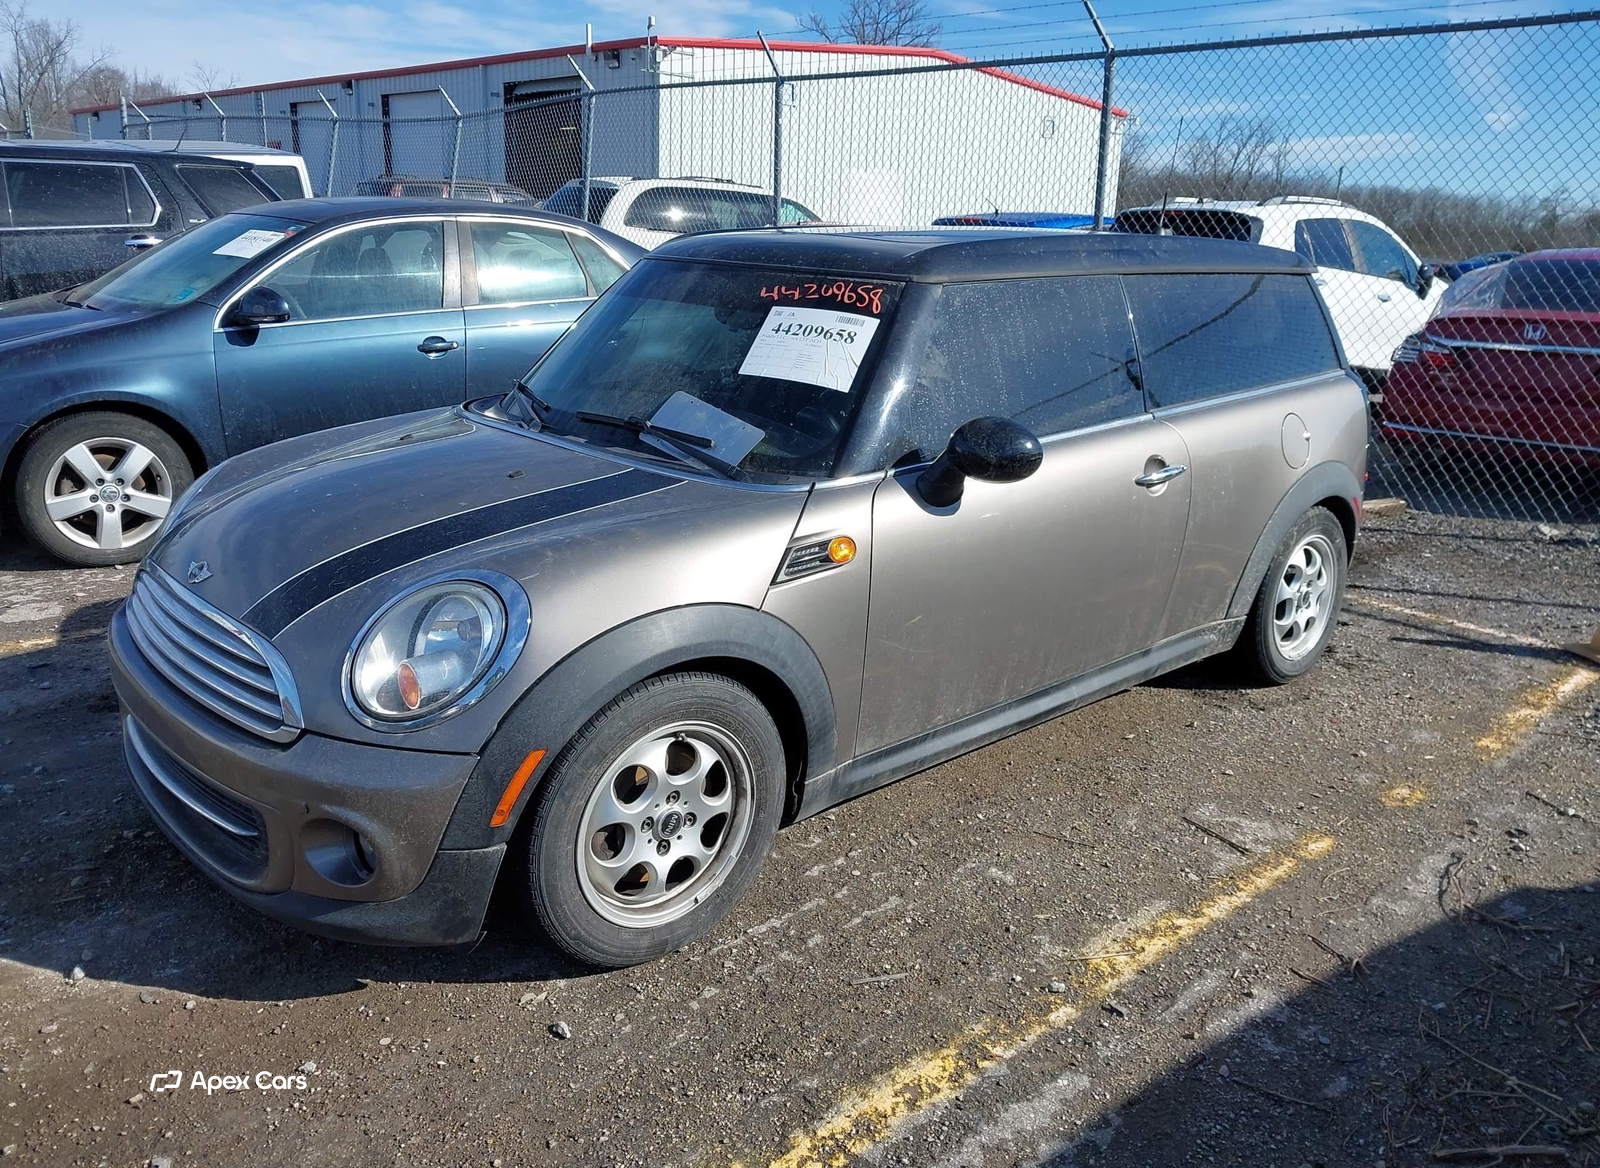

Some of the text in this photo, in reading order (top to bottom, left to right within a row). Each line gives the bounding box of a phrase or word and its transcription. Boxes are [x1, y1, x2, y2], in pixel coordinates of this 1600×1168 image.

[760, 281, 883, 315] 44209658
[771, 321, 857, 345] 44209658
[664, 814, 679, 835] MINI
